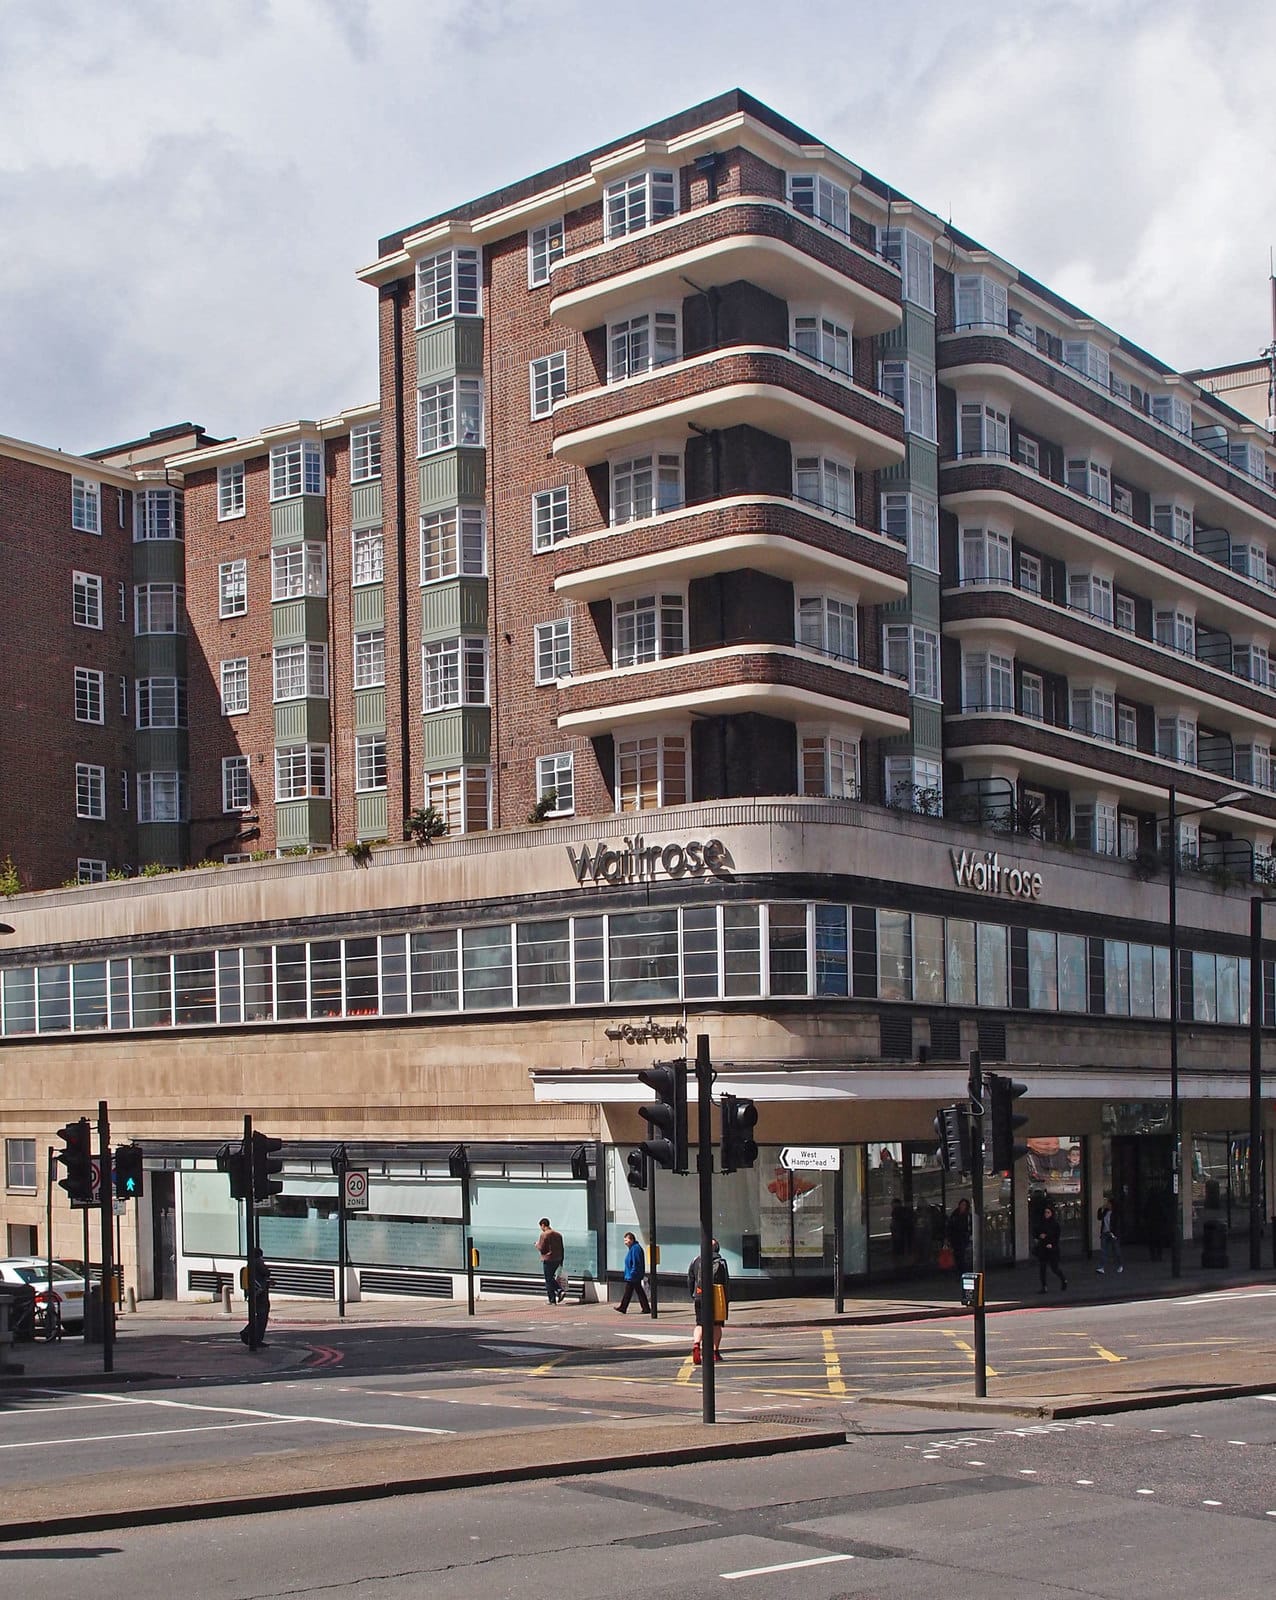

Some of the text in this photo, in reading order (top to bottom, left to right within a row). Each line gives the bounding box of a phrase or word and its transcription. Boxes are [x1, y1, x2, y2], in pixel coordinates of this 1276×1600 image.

[566, 833, 727, 882] Waitrose
[949, 848, 1043, 900] Waitrose
[800, 1151, 817, 1159] West
[349, 1180, 363, 1190] 20
[347, 1198, 366, 1206] ZONE
